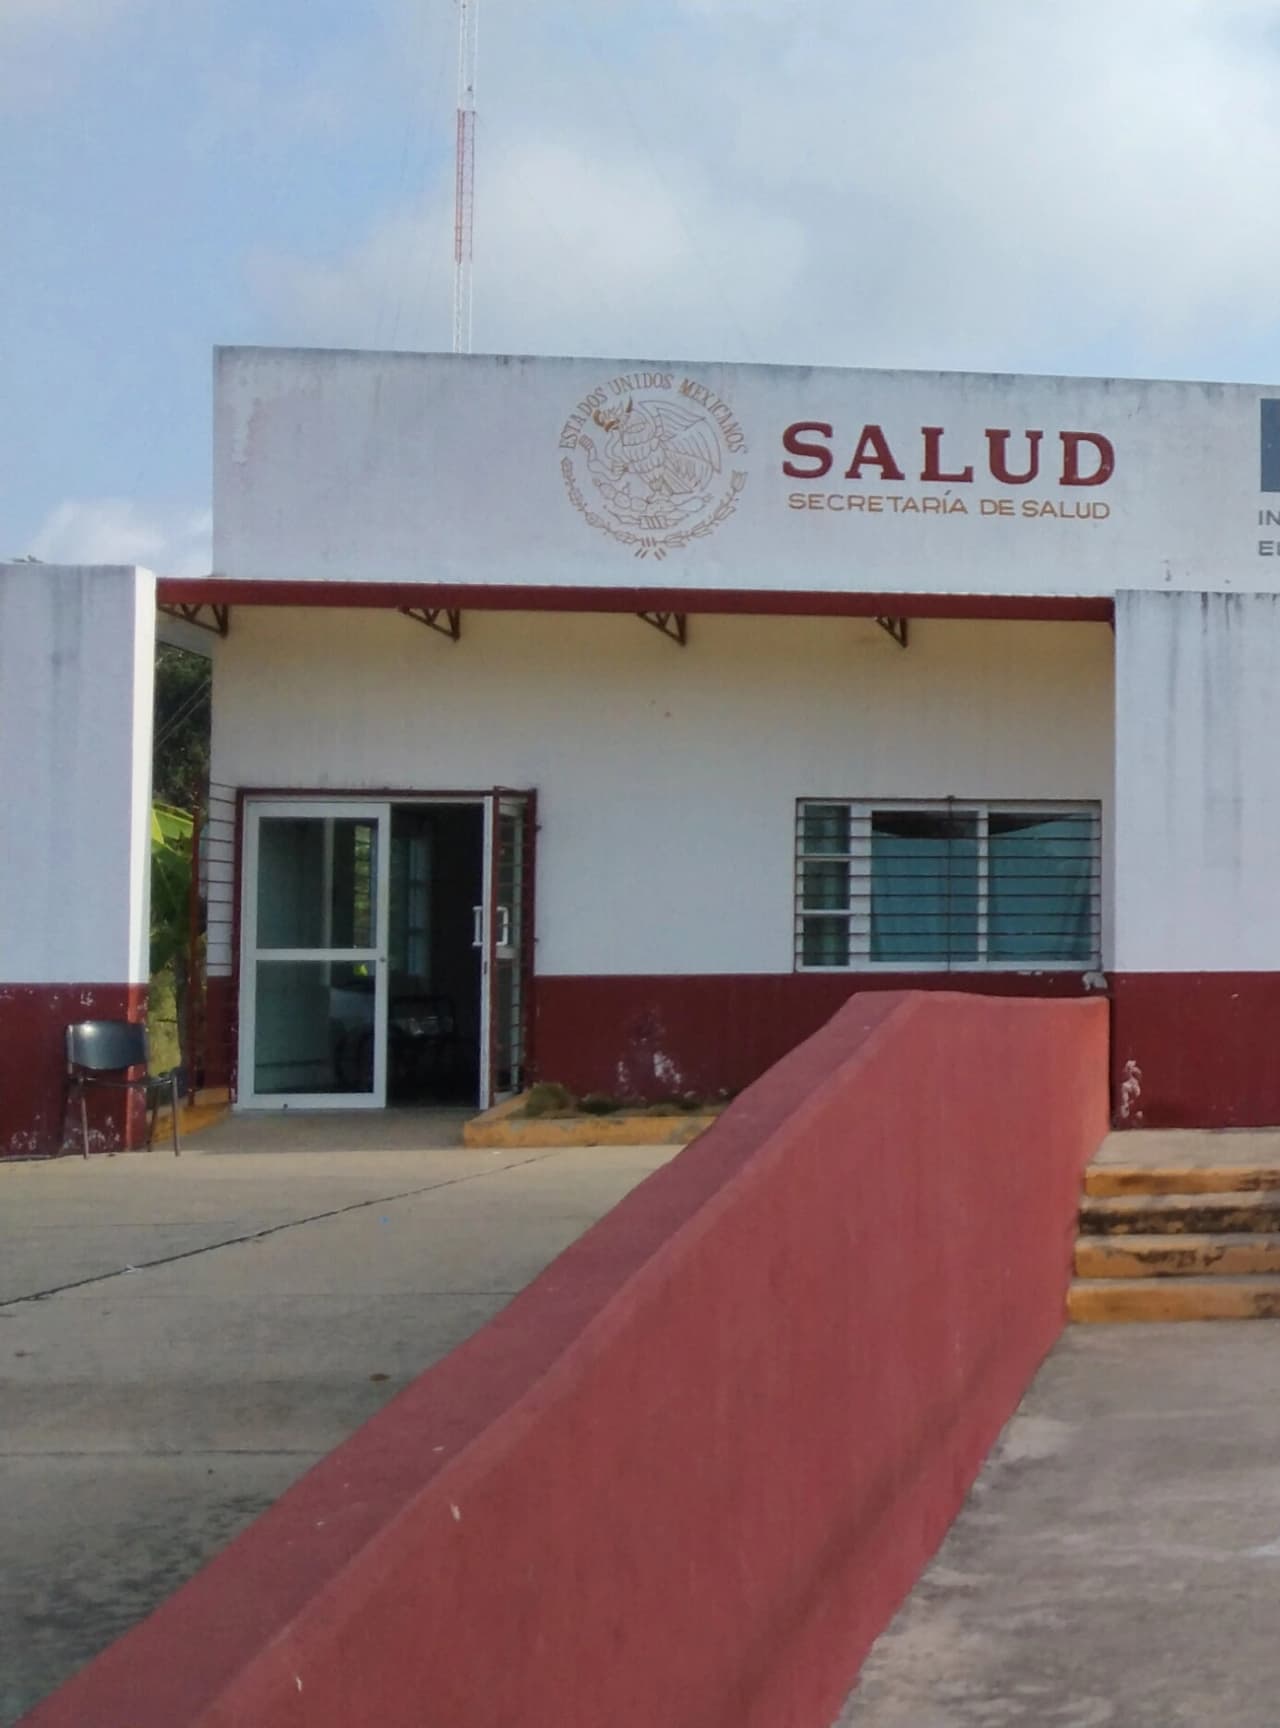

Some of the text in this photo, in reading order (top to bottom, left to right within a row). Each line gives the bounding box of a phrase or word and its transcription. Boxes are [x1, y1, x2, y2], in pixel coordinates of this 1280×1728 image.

[558, 372, 749, 455] ESTADOS UNIDOS MEXICANOS
[781, 421, 1116, 486] SALUD
[787, 490, 1110, 521] SECRETARÍA DE SALUD
